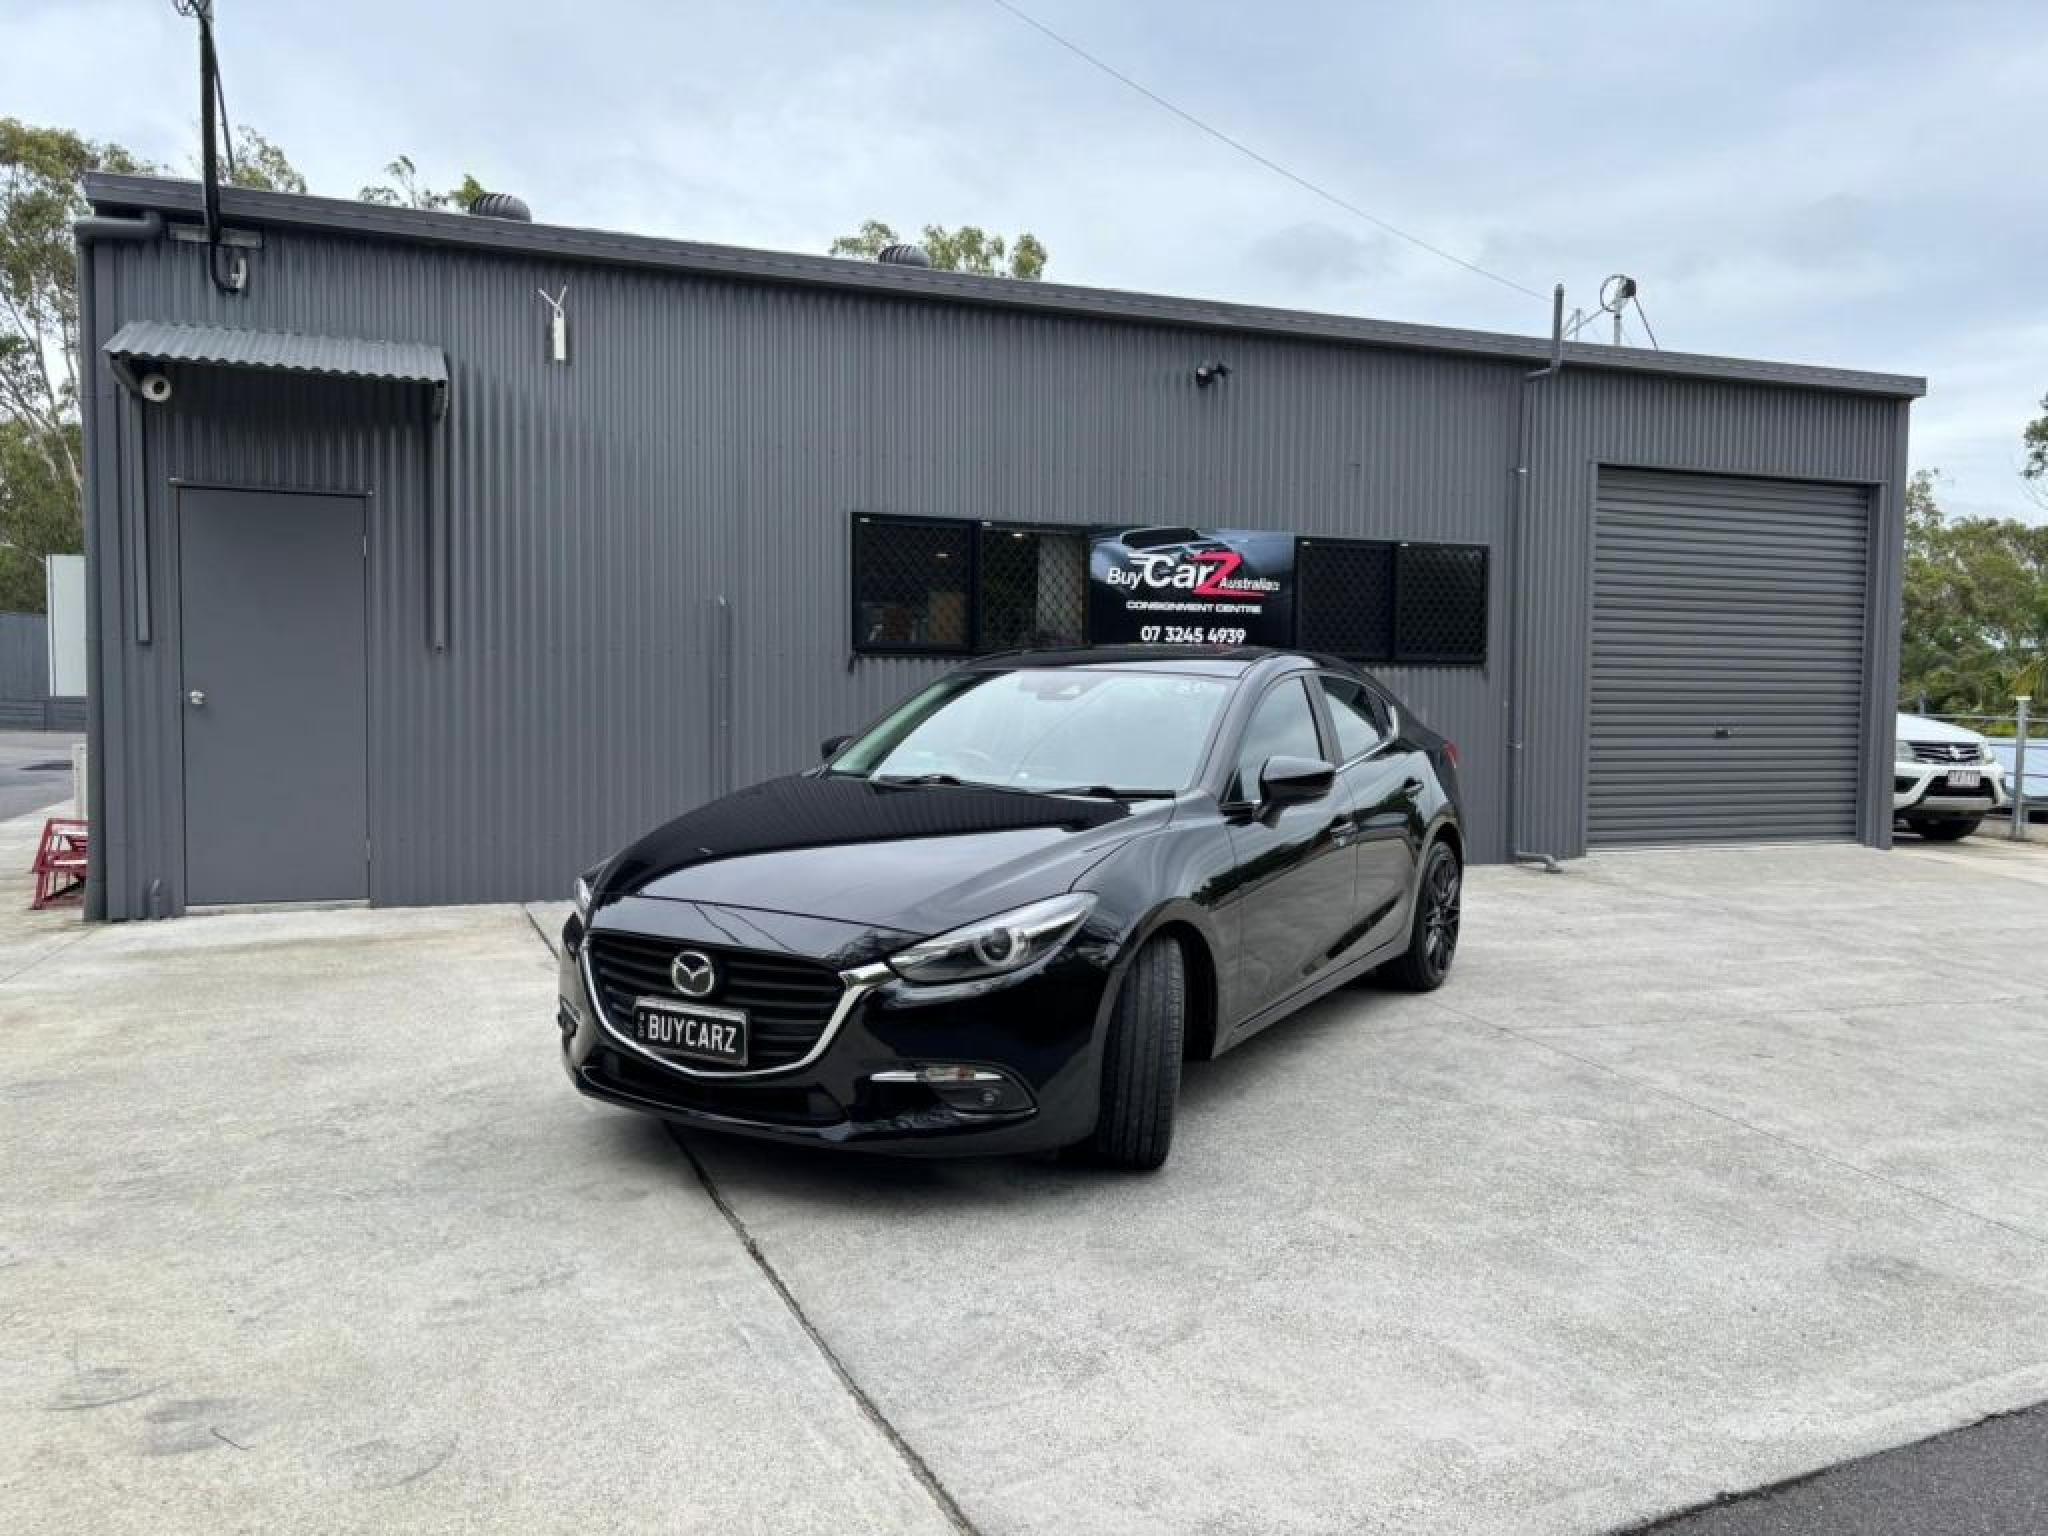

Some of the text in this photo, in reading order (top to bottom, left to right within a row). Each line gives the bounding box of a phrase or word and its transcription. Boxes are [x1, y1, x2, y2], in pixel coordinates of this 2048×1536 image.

[1125, 600, 1214, 613] CONSIGNMENT
[1140, 625, 1247, 644] 07 3245 4939
[648, 1013, 737, 1053] BUYCARZ
